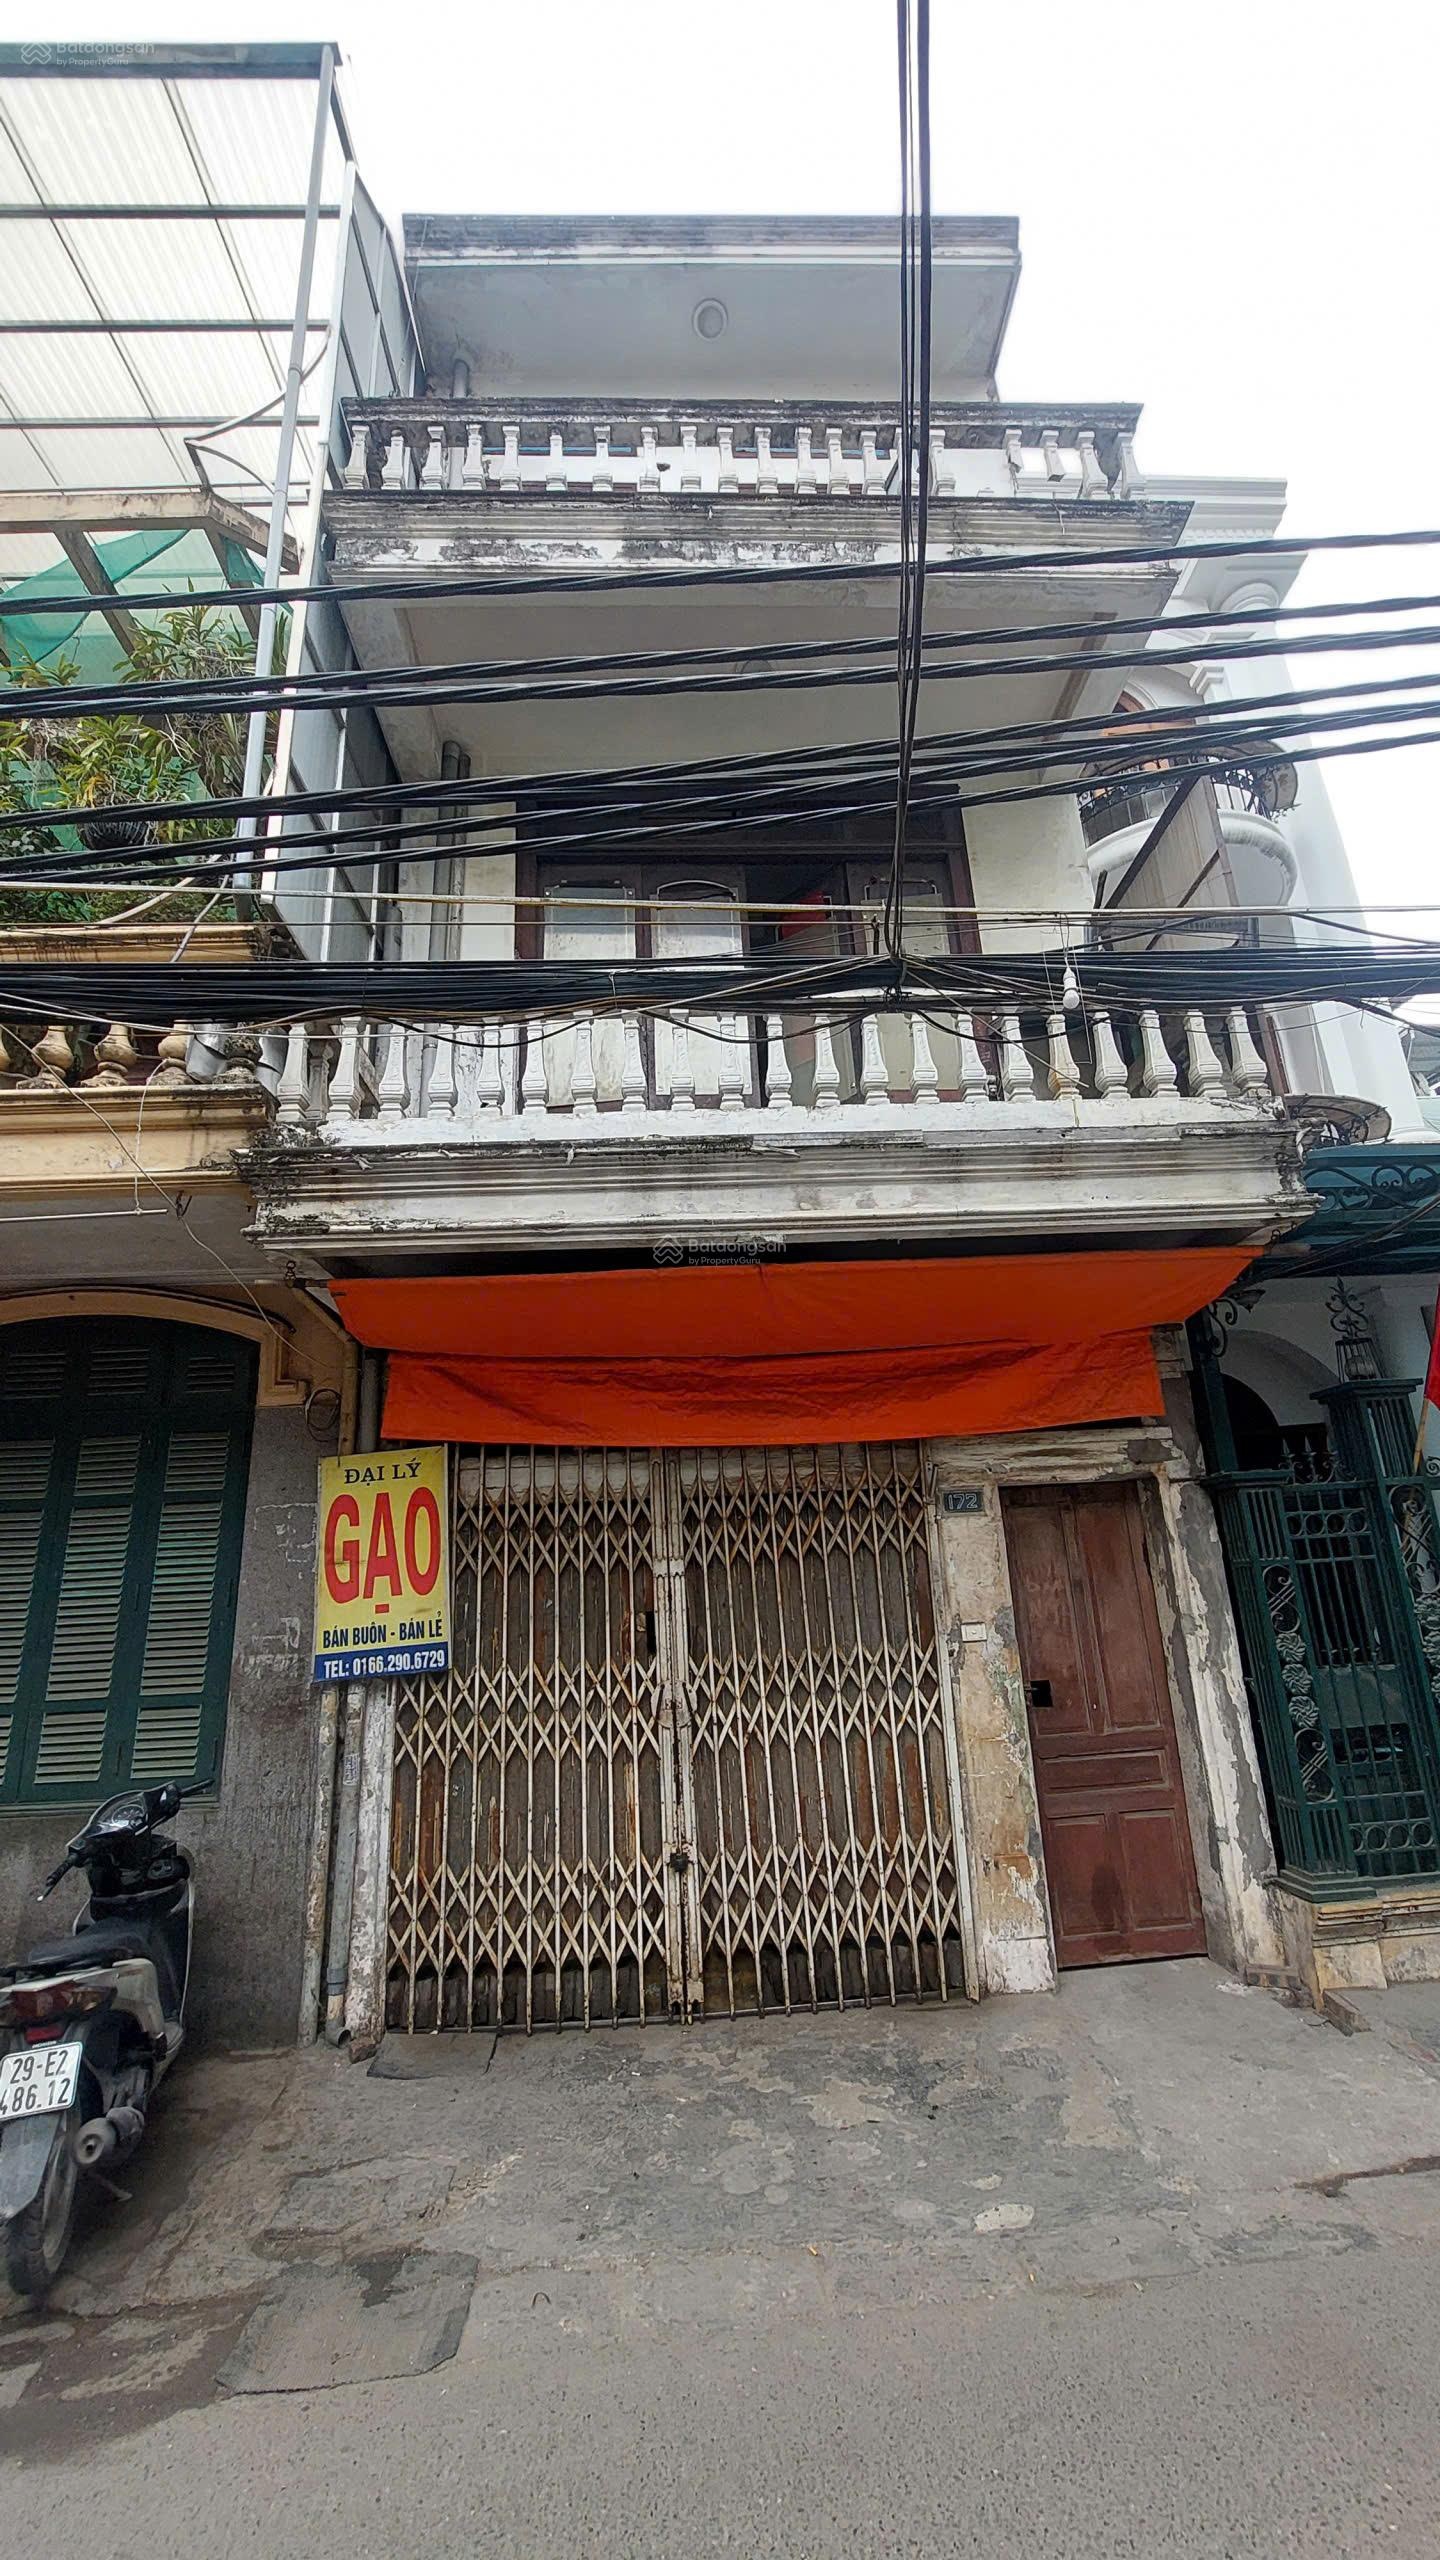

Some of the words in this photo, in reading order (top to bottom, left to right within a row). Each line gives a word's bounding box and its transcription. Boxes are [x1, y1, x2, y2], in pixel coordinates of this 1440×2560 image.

[344, 1466, 385, 1486] ĐẠI
[392, 1458, 422, 1479] LÝ
[948, 1493, 978, 1510] 172
[324, 1486, 441, 1614] GẠO
[323, 1625, 349, 1648] BÁN
[352, 1621, 387, 1645] BUÔN
[399, 1618, 425, 1641] BÁN
[429, 1611, 443, 1638] LẺ
[324, 1660, 350, 1679] TEL:
[352, 1650, 445, 1676] 0166.290.6729
[10, 2050, 69, 2085] 29-E2
[0, 2077, 71, 2115] 486.12
